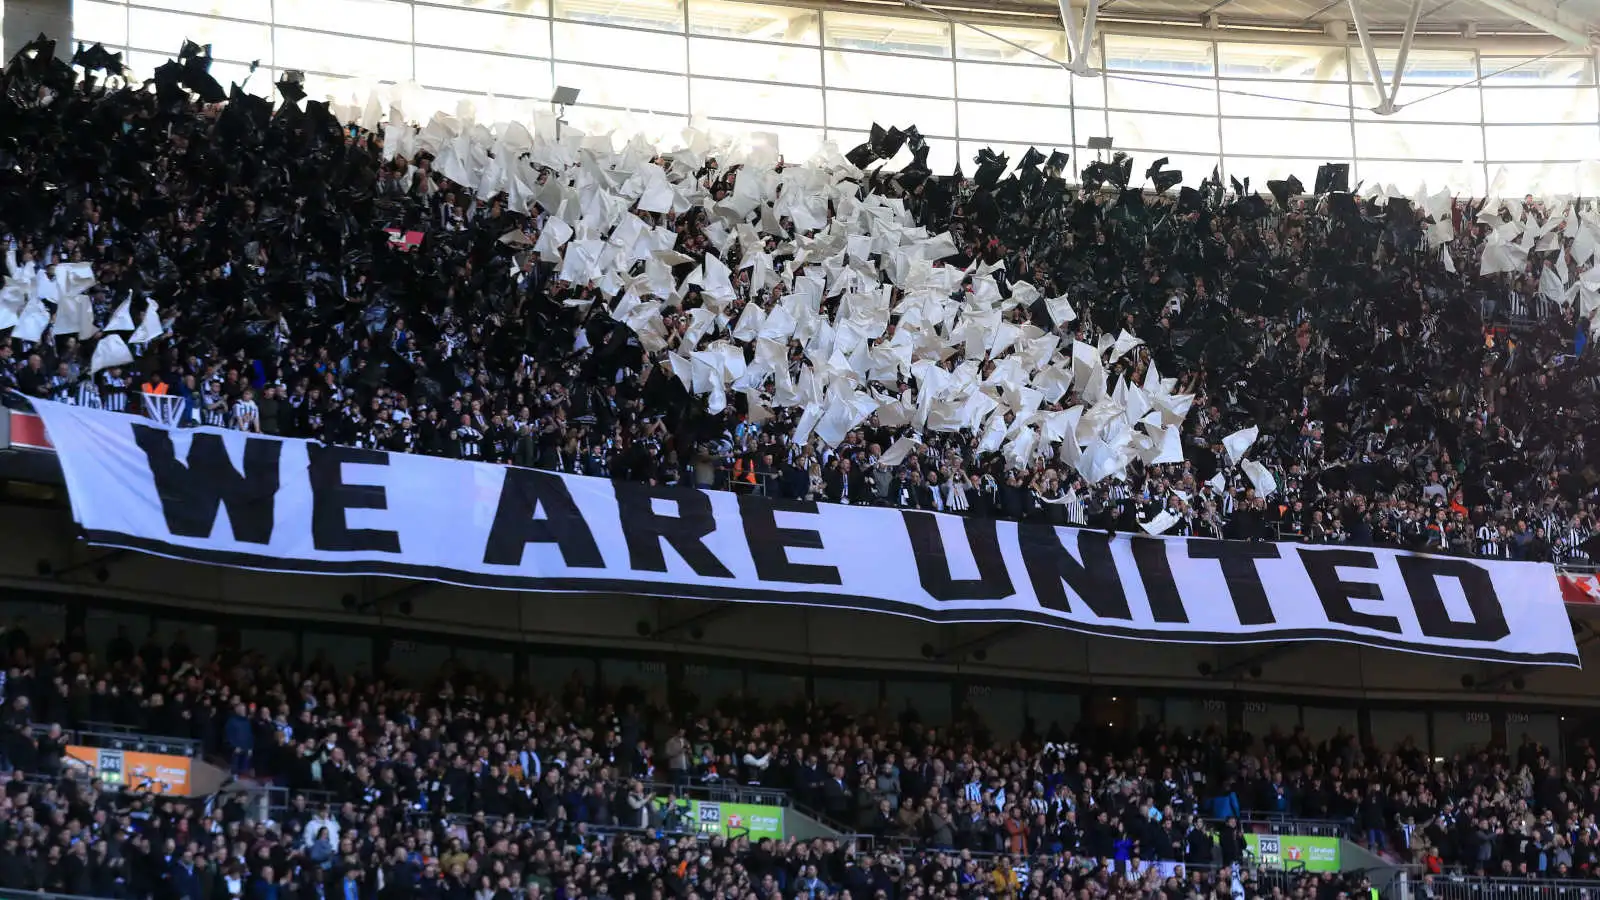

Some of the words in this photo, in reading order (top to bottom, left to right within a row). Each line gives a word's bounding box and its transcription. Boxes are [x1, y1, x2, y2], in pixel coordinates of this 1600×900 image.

[131, 422, 402, 553] WE
[483, 466, 843, 585] ARE
[901, 509, 1511, 642] UNITED
[102, 756, 121, 769] 241
[701, 809, 719, 821] 242
[1261, 841, 1278, 853] 243
